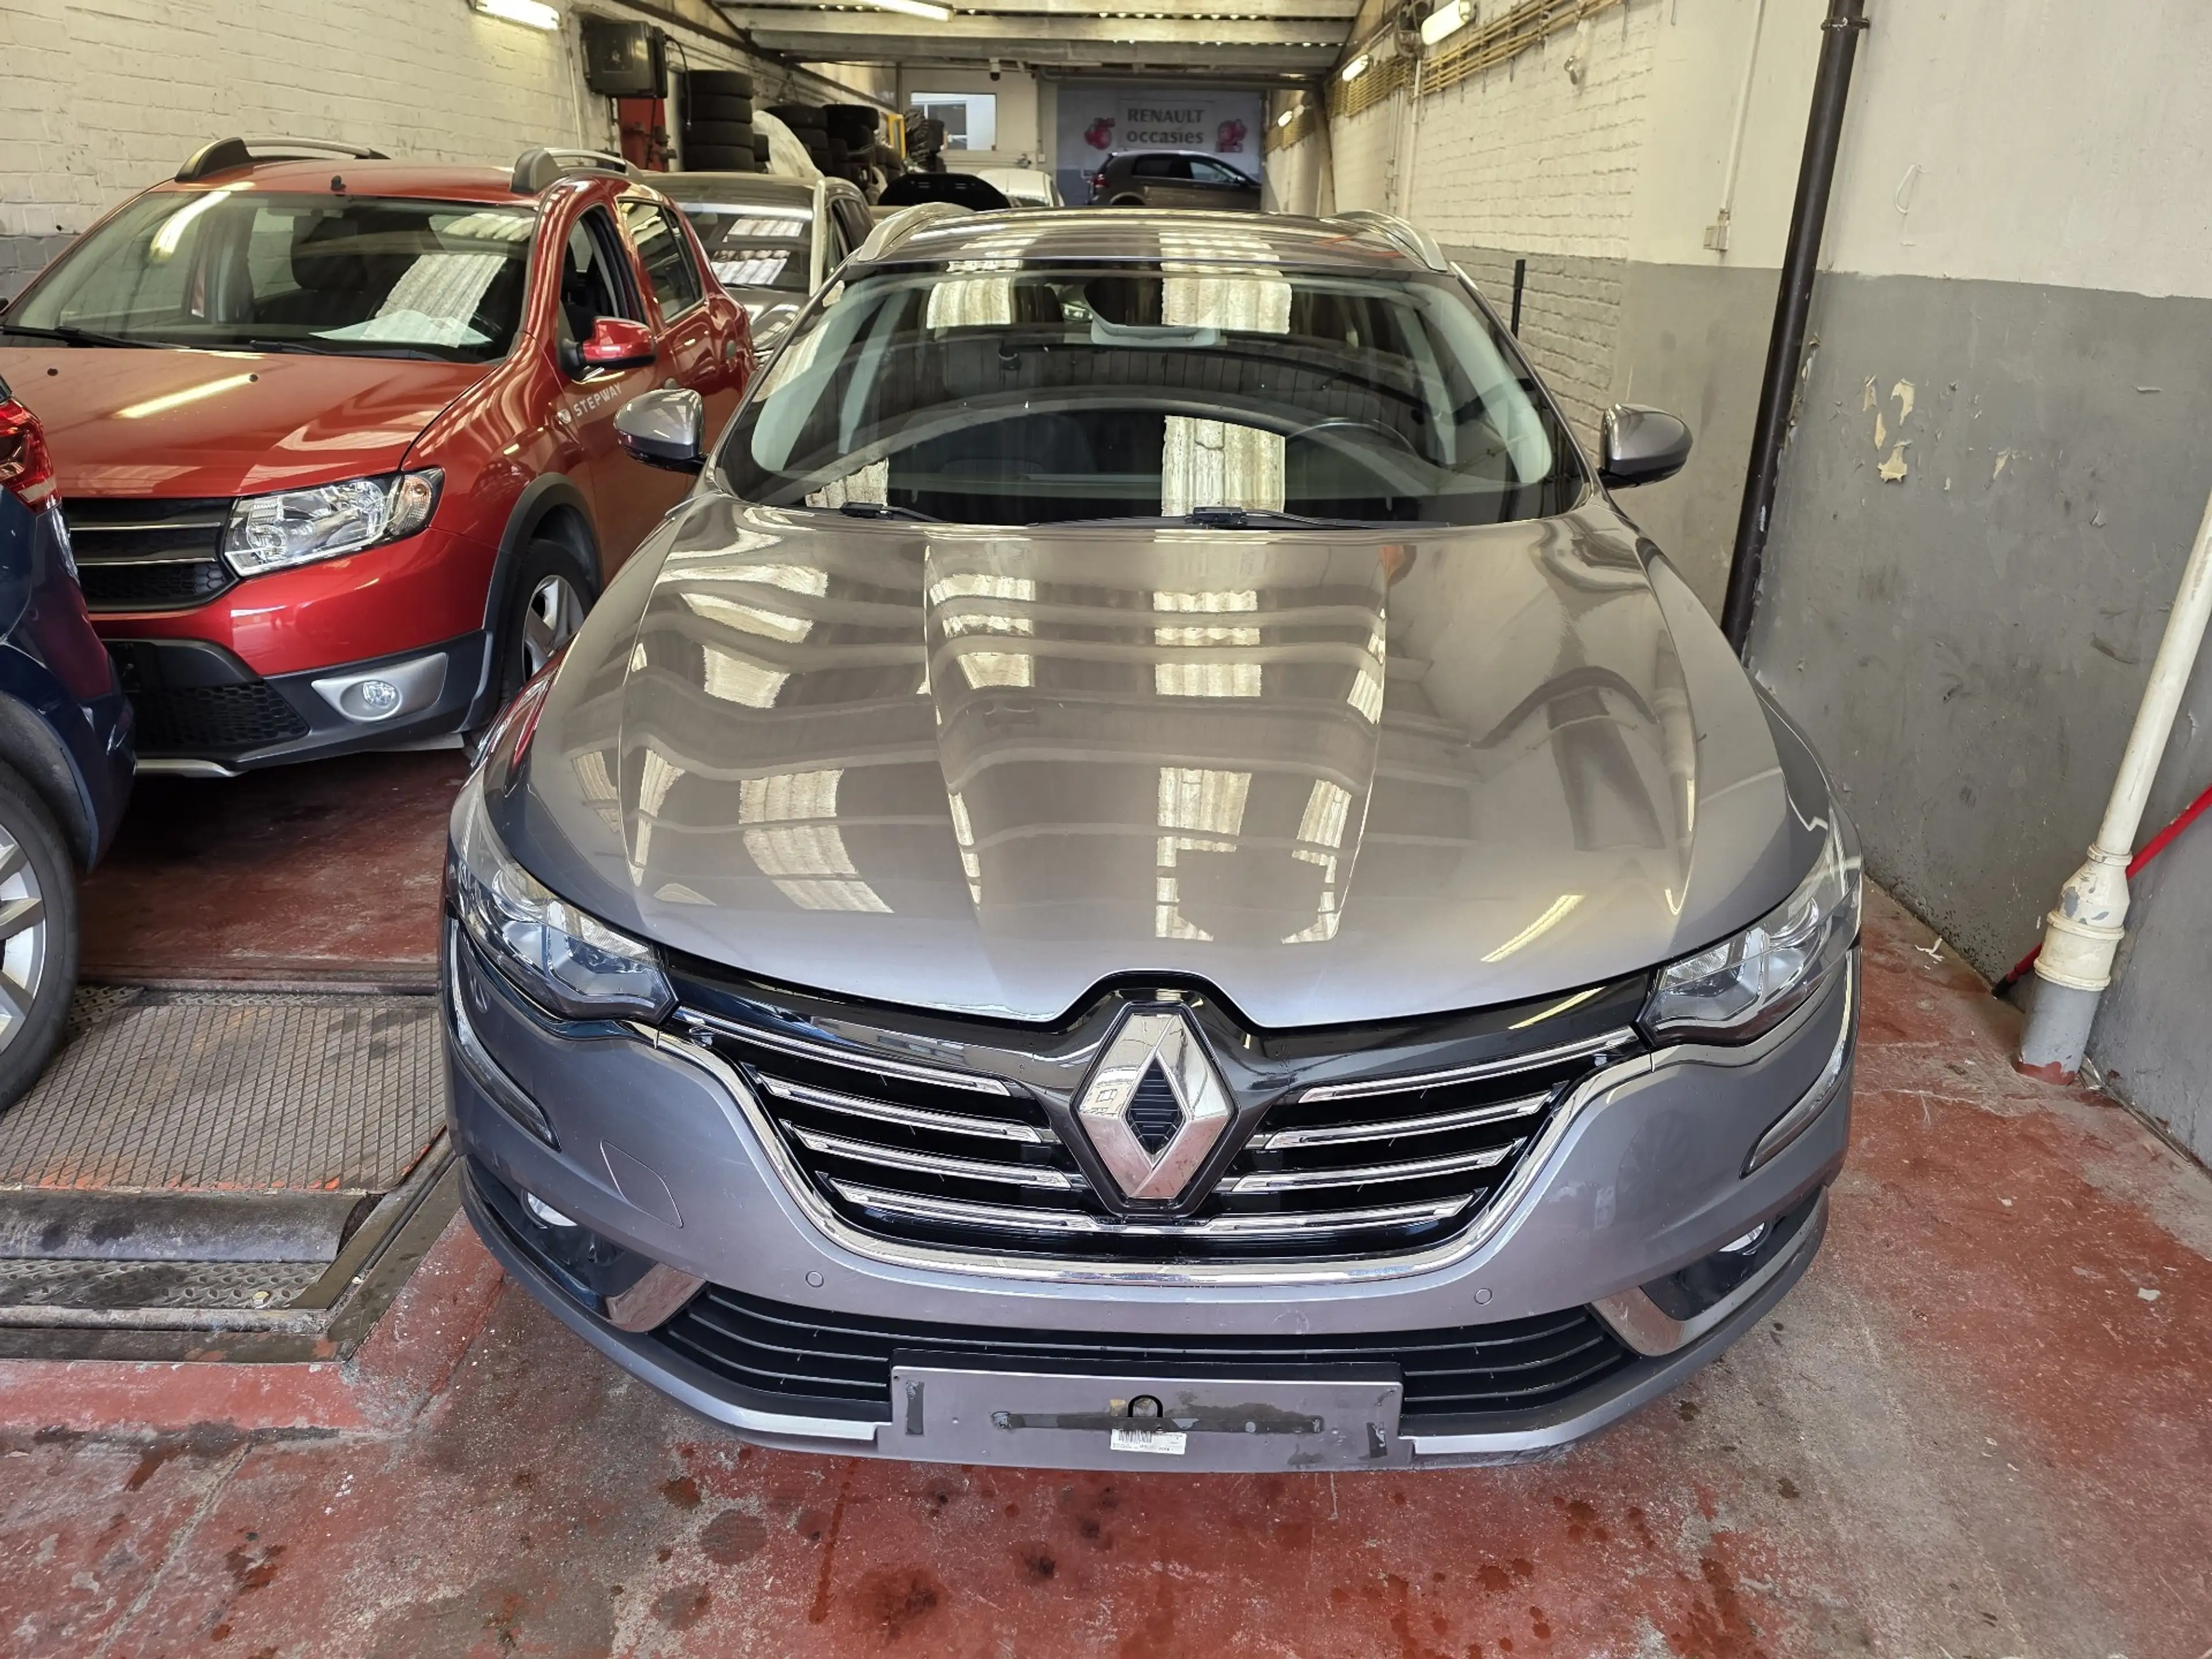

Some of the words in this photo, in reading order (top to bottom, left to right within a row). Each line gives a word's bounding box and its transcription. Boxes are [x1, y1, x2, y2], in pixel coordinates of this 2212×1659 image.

[1127, 108, 1205, 123] RENAULT
[1127, 130, 1204, 144] occasies
[573, 382, 622, 416] STEPWAY
